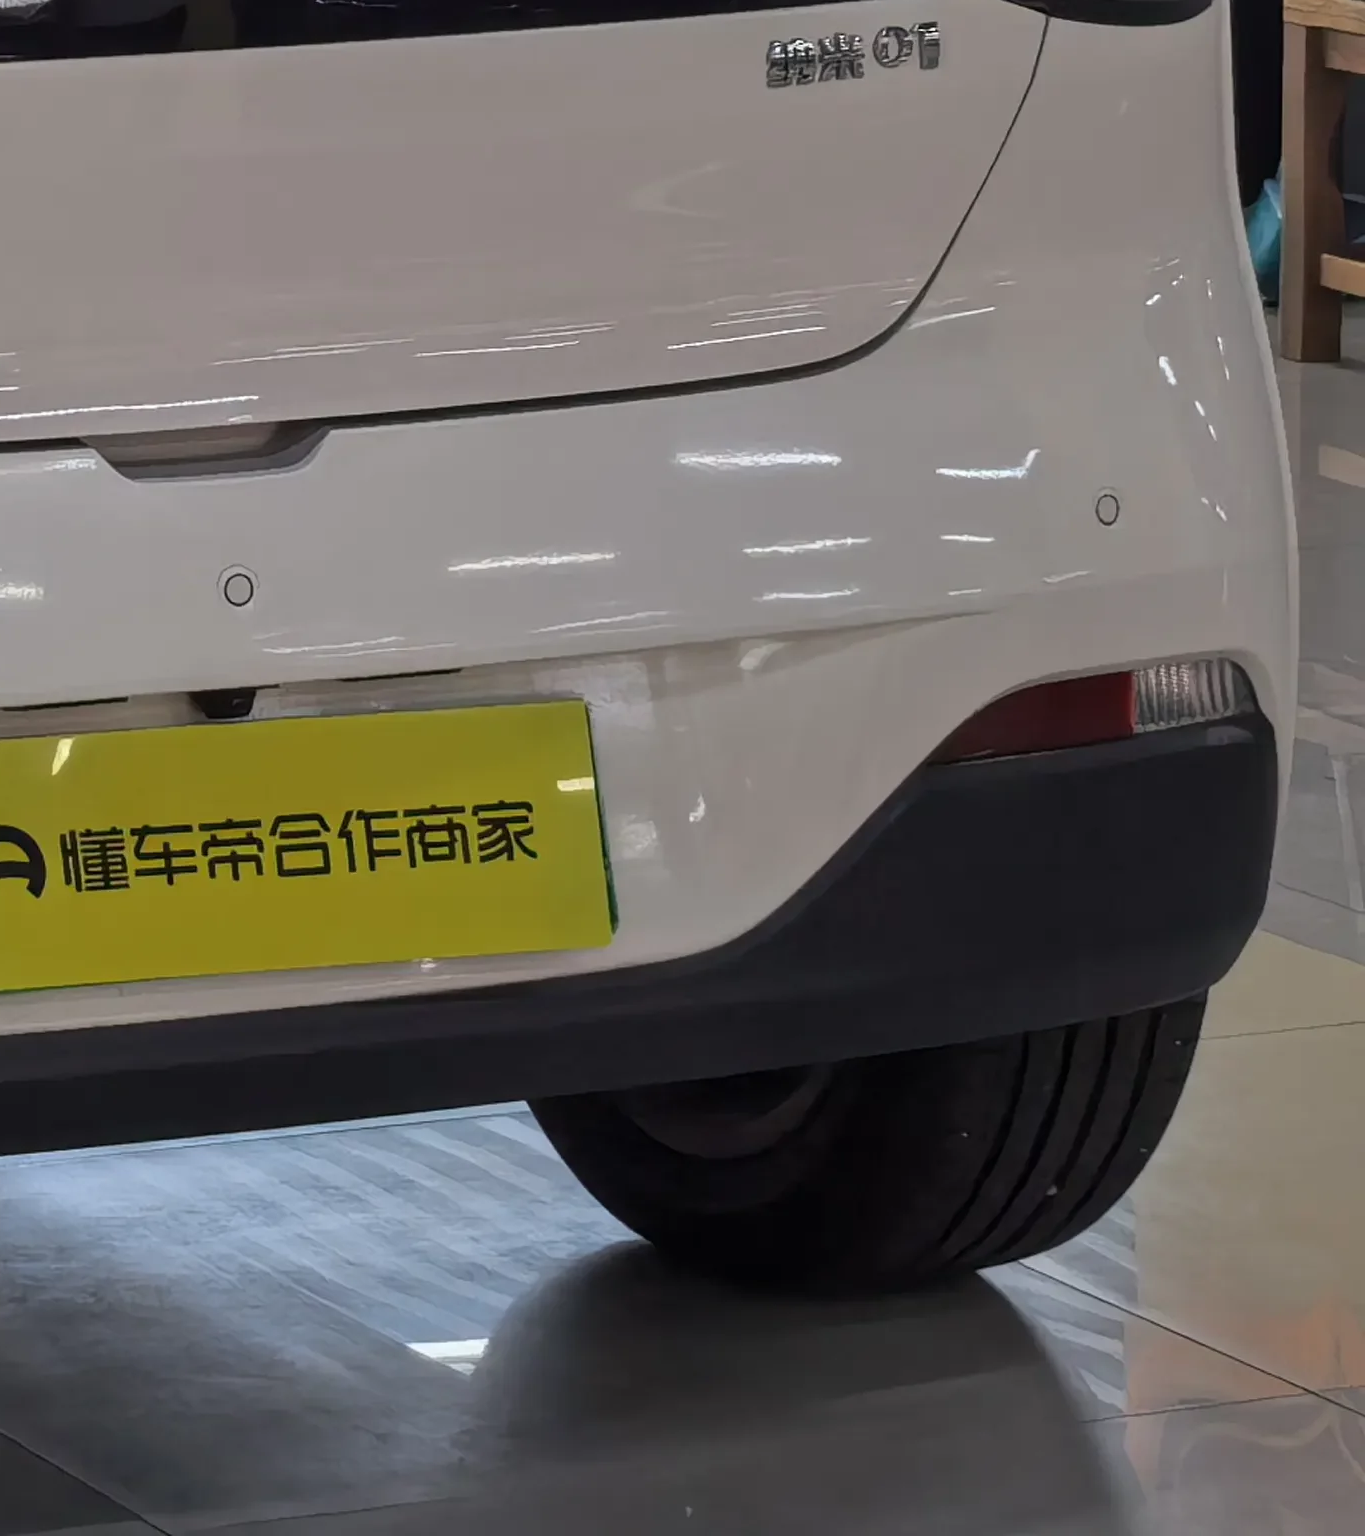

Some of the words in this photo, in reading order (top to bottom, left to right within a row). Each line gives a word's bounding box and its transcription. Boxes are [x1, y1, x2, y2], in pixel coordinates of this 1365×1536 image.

[59, 800, 538, 892] 懂车帝合作商家
